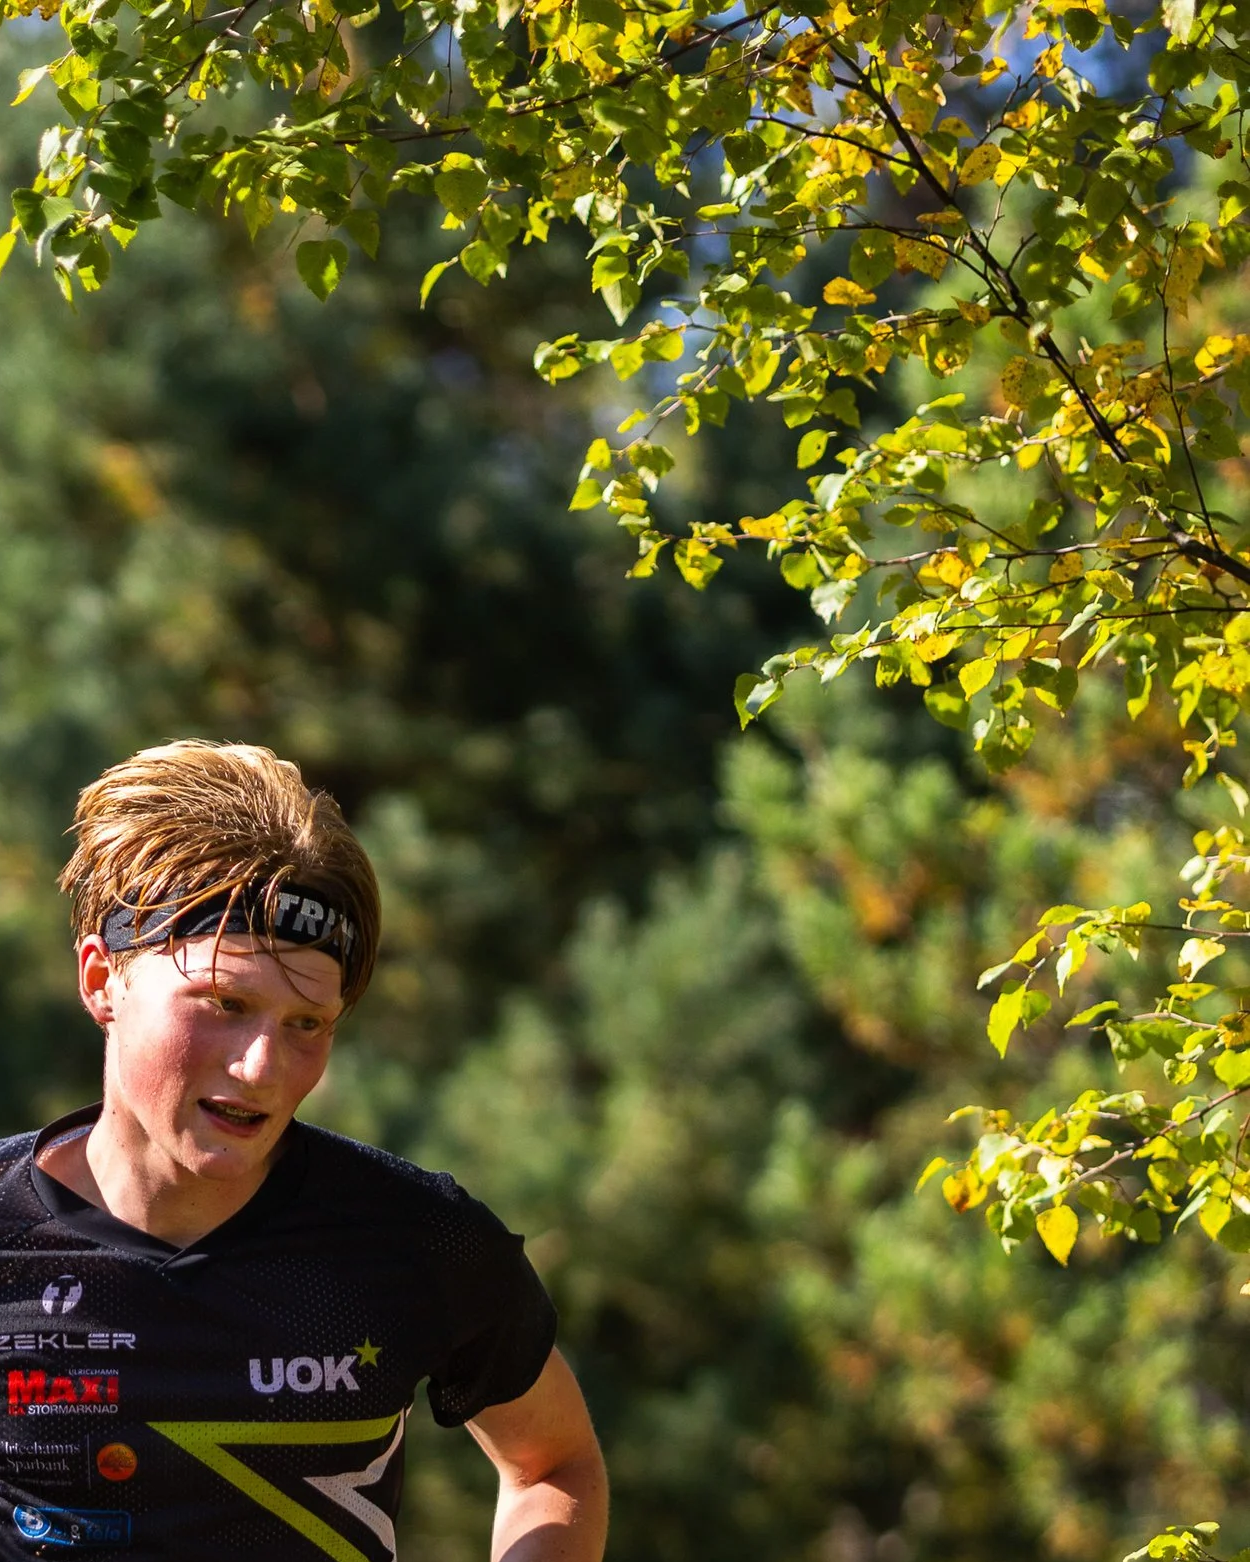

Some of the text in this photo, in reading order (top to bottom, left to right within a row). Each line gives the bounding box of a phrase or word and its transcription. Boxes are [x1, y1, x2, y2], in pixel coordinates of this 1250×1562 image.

[7, 1370, 119, 1404] MAXI
[249, 1355, 361, 1393] UOK
[27, 1404, 119, 1415] STORMARKNAD
